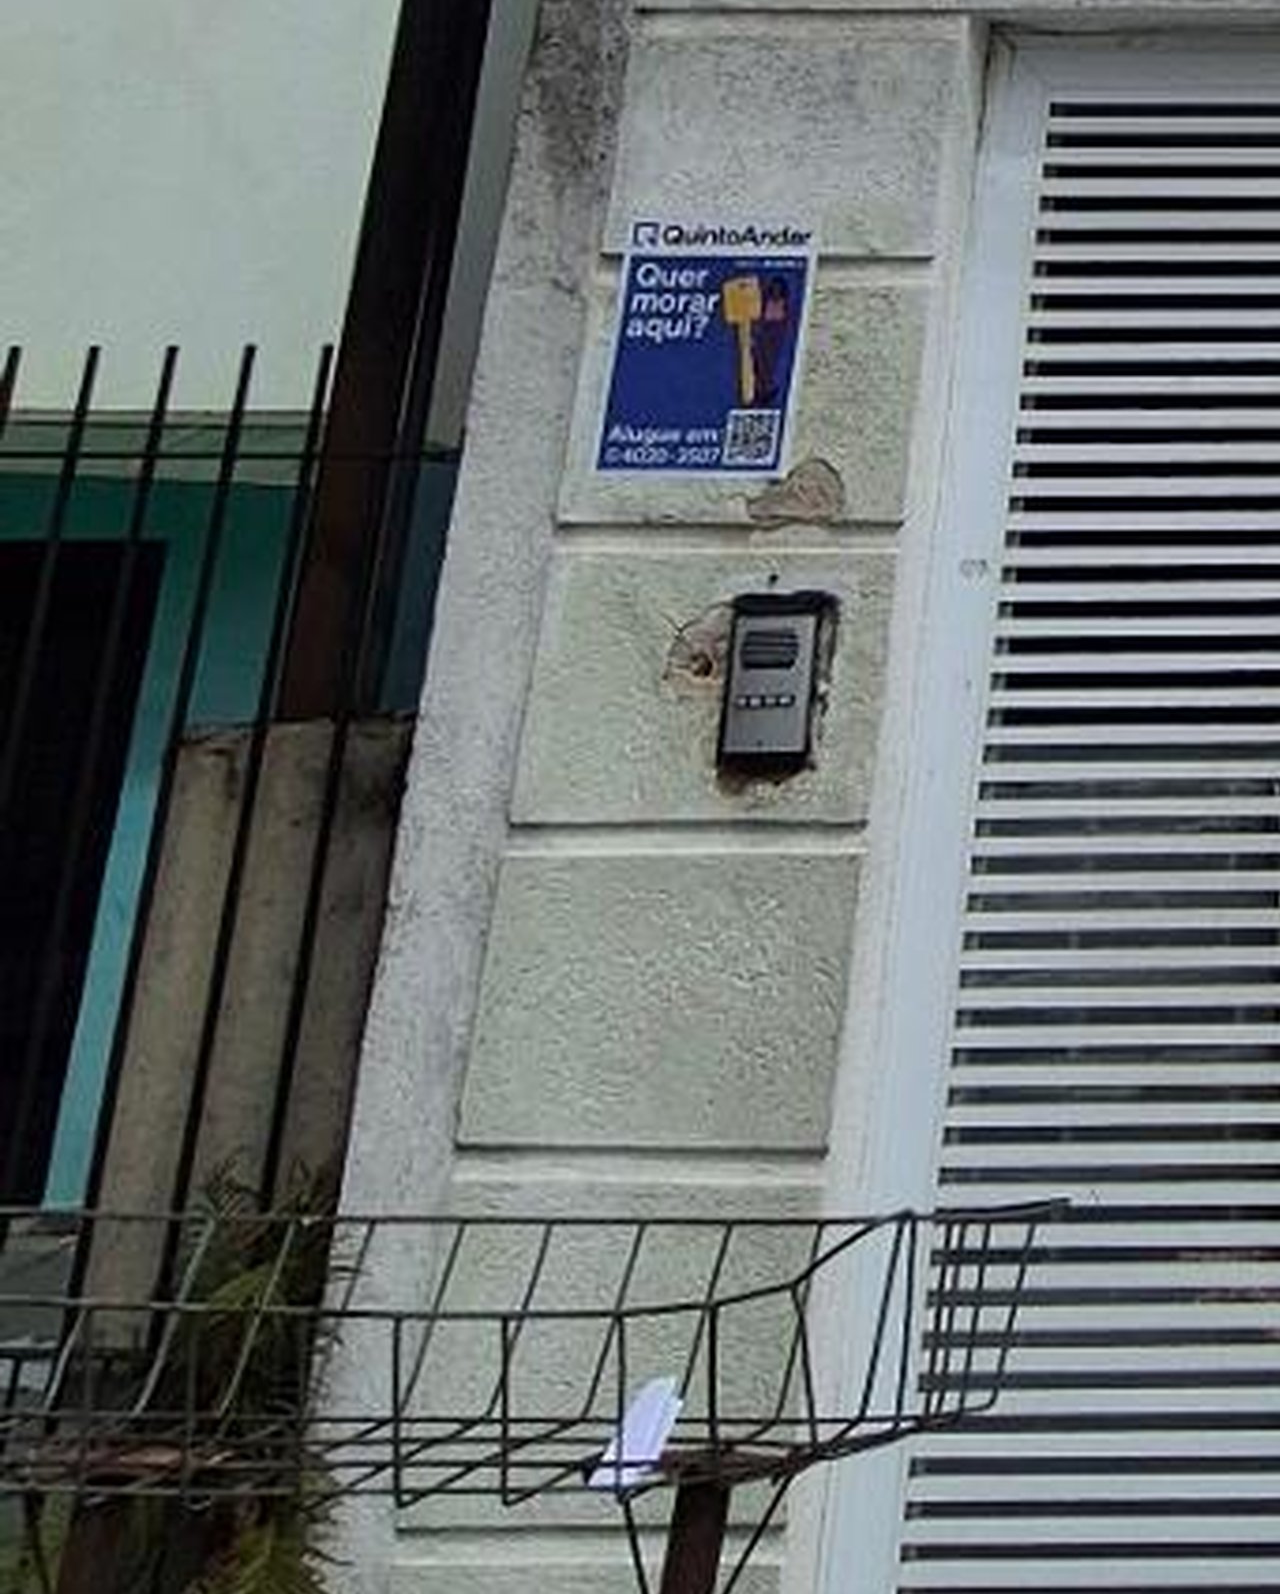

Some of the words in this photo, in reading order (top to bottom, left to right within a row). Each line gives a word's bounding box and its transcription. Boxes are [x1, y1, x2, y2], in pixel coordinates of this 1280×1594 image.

[662, 225, 812, 246] QuintoAndar
[636, 263, 709, 289] Quer
[631, 292, 720, 313] morar
[626, 316, 710, 344] aqui?
